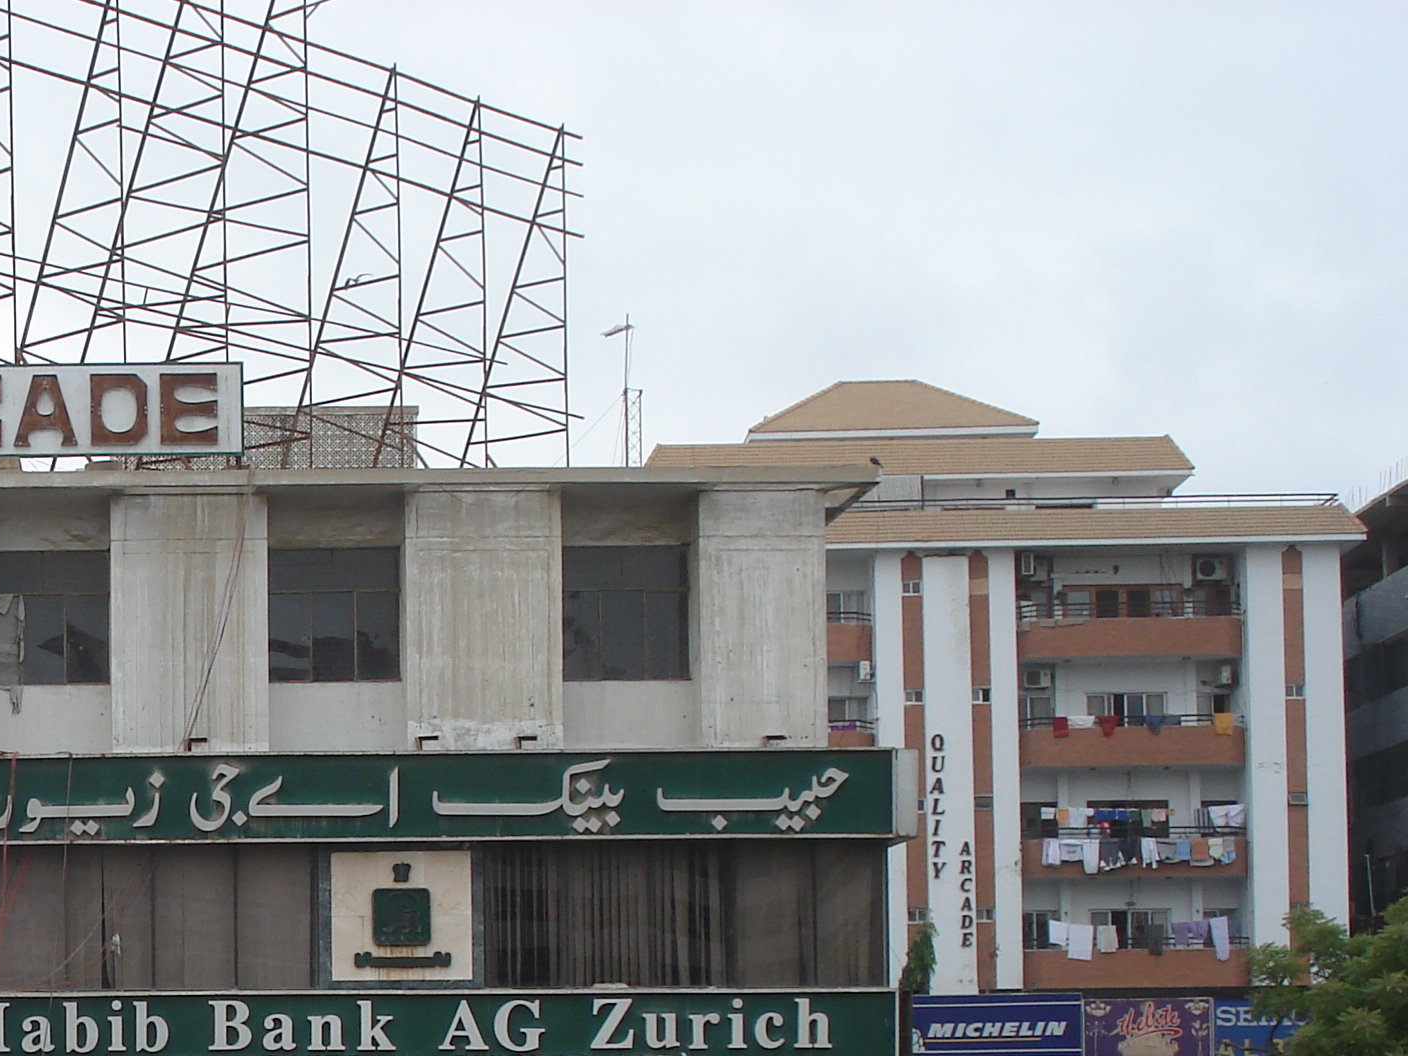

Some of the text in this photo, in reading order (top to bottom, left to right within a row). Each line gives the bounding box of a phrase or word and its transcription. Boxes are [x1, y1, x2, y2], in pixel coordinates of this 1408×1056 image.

[432, 758, 625, 833] بینک
[656, 766, 850, 832] حبیب
[929, 733, 974, 948] QUALITY ARCADE
[208, 999, 397, 1052] Bank
[437, 997, 546, 1052] AG
[589, 997, 834, 1051] Zurich
[927, 1021, 1068, 1038] MICHELIN
